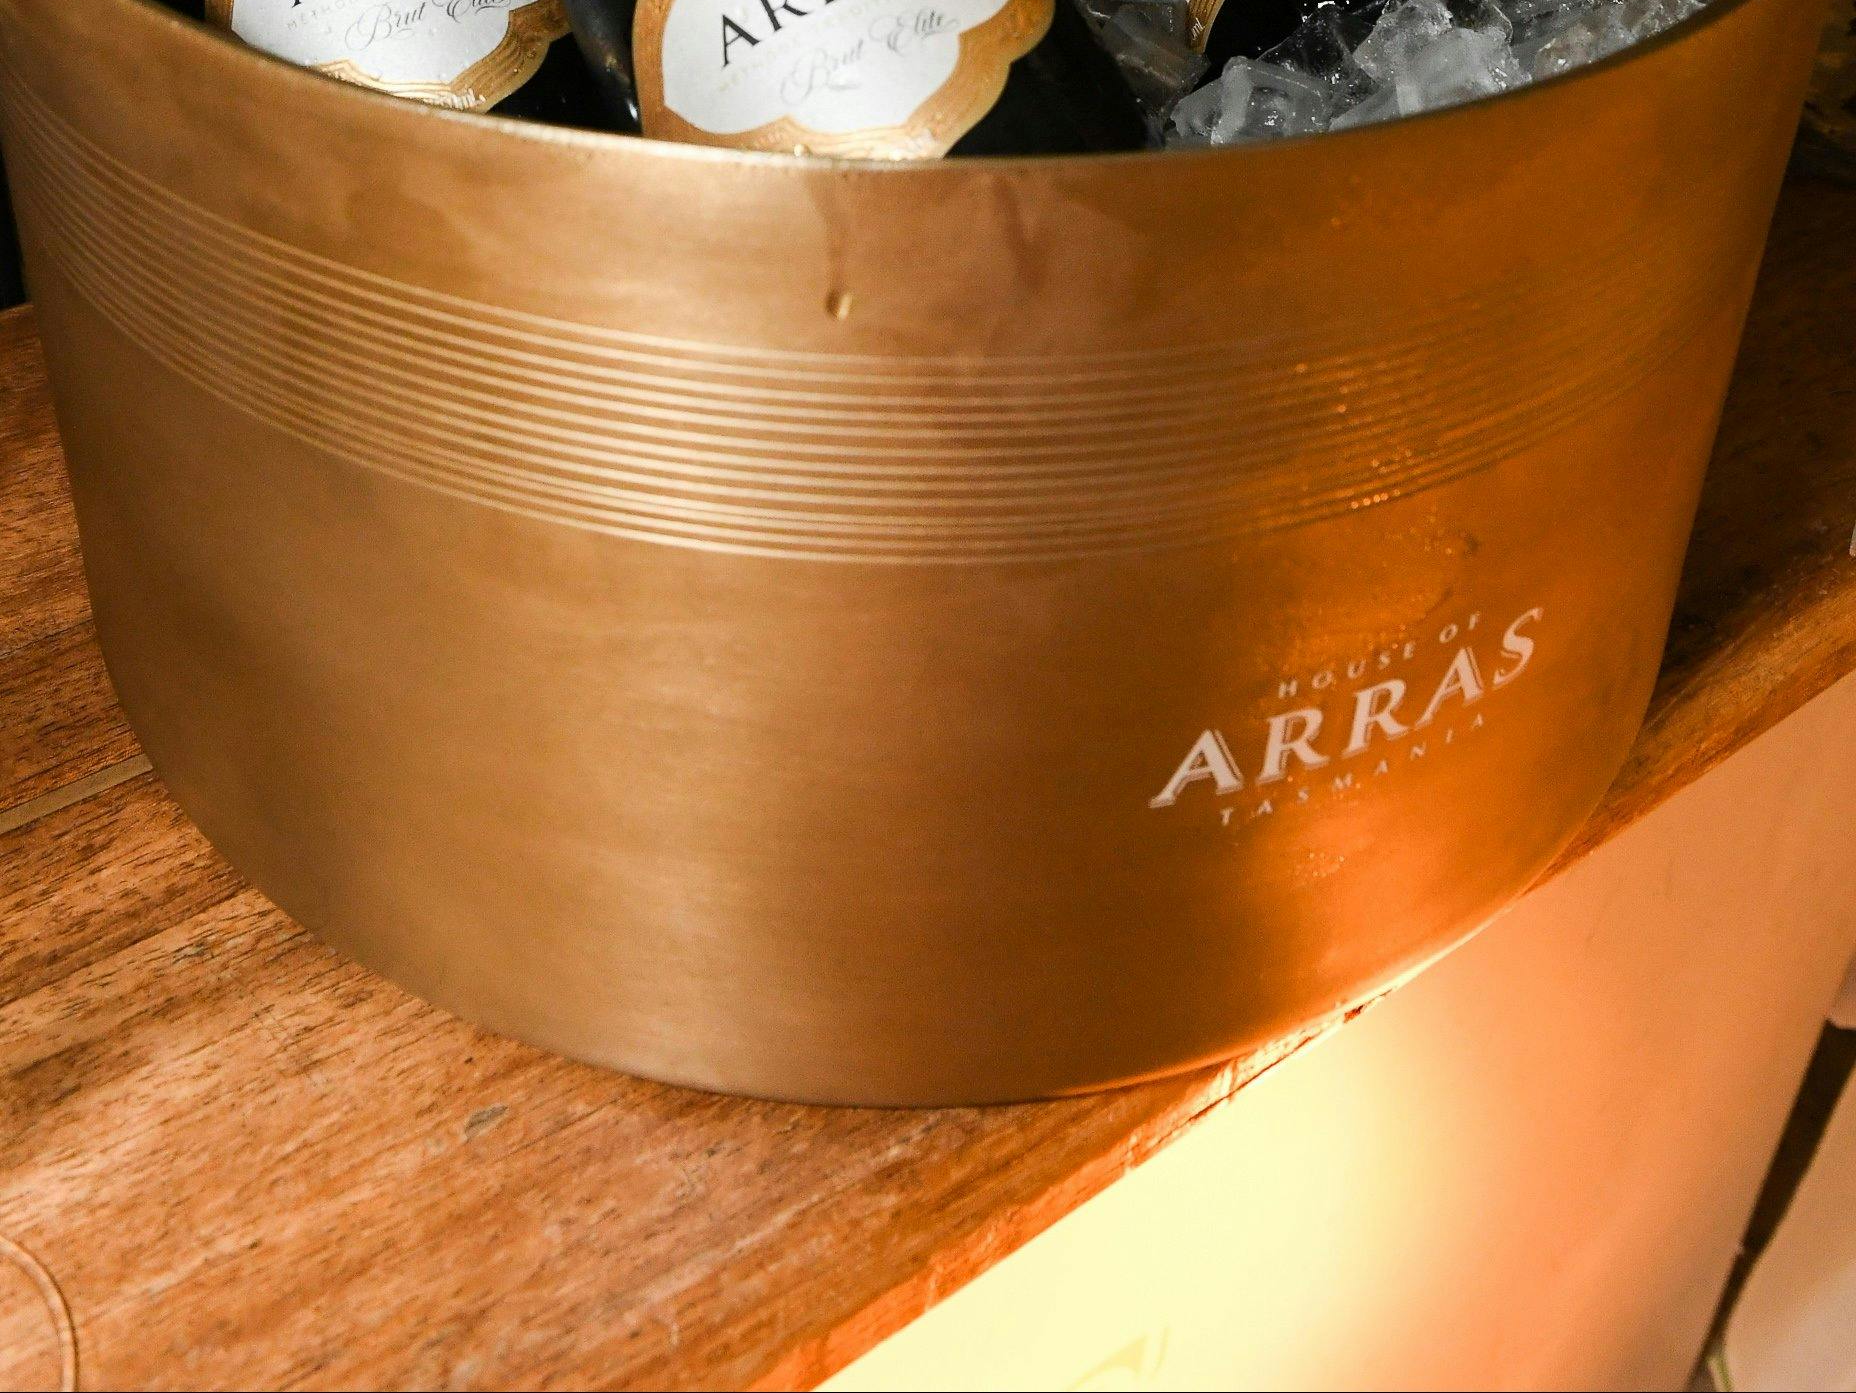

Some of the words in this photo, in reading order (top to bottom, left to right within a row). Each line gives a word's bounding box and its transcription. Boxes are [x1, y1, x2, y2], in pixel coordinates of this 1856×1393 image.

[345, 1, 426, 51] Brut
[1276, 639, 1418, 700] HOUSE
[1437, 609, 1483, 645] OF
[1148, 606, 1544, 809] ARRAS
[1218, 711, 1485, 827] TASMANIA
